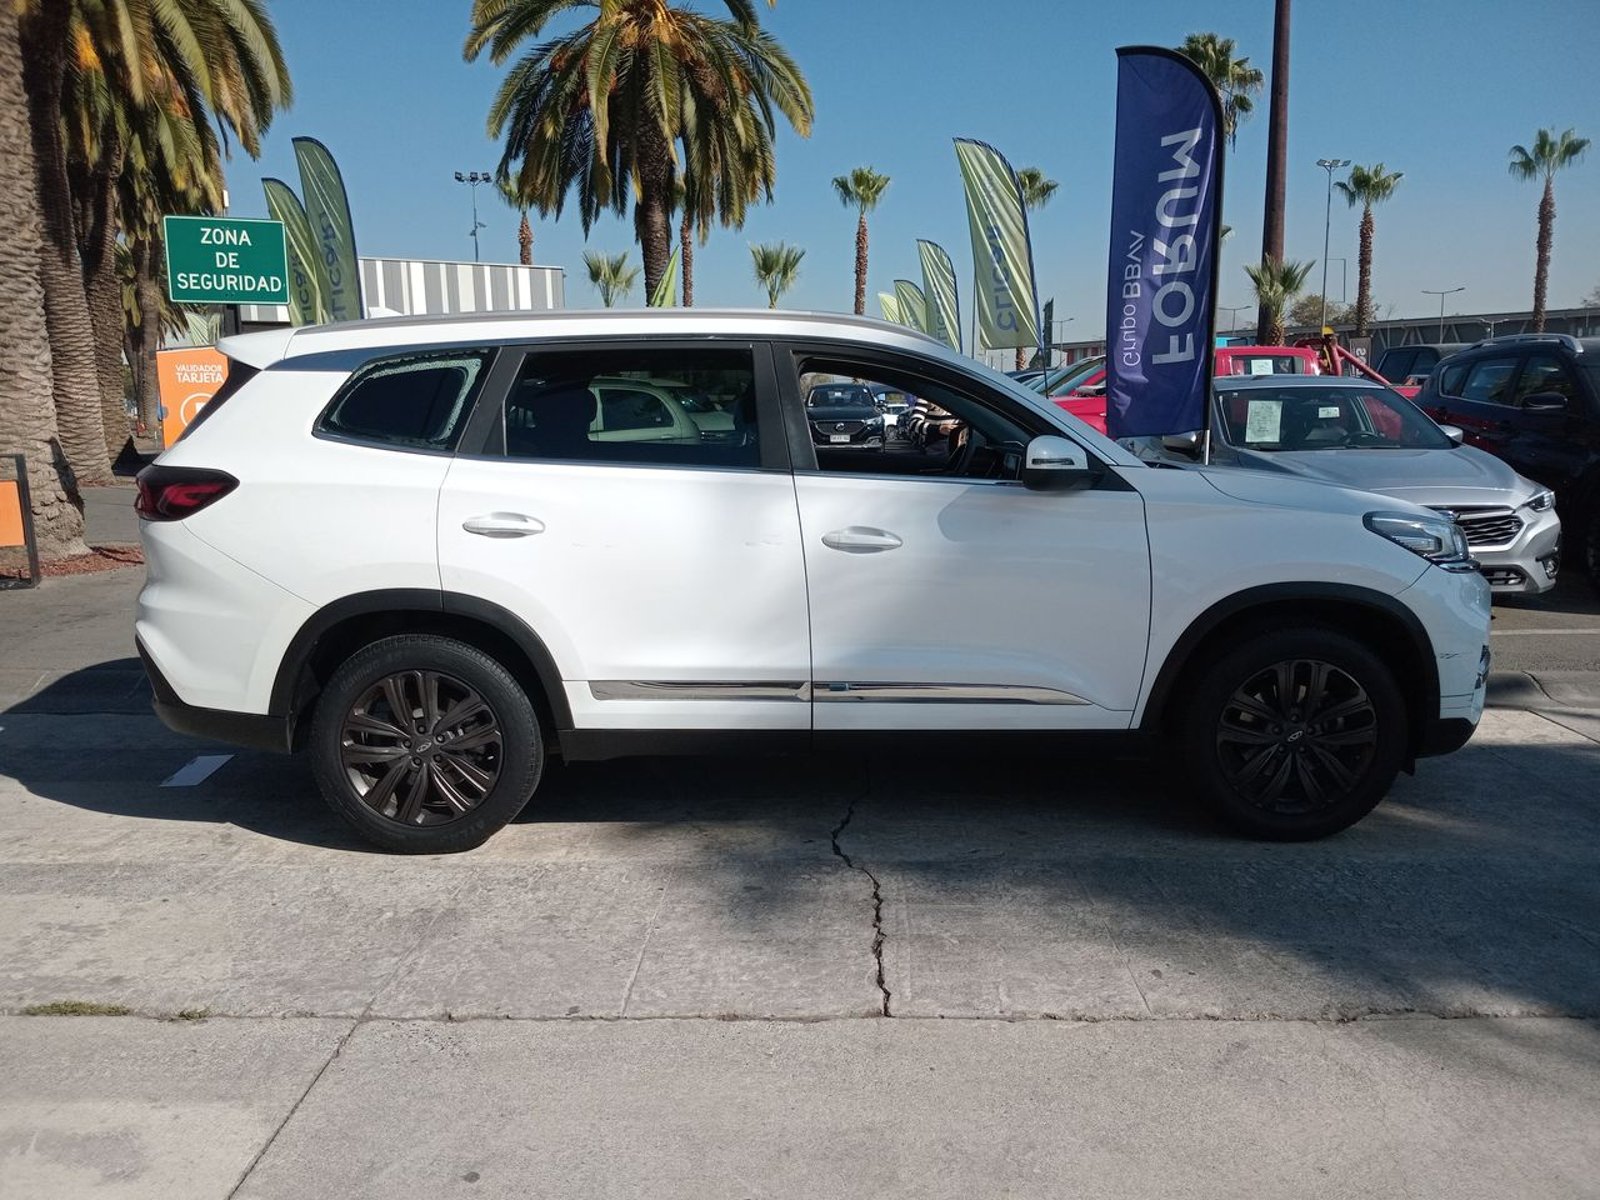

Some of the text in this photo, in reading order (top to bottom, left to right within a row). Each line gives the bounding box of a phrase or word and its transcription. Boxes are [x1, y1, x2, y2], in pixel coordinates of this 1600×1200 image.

[200, 227, 252, 246] ZONA
[215, 251, 240, 268] DE
[176, 272, 282, 292] SEGURIDAD
[175, 363, 223, 372] VALIDADOR
[176, 372, 225, 383] TARJETA
